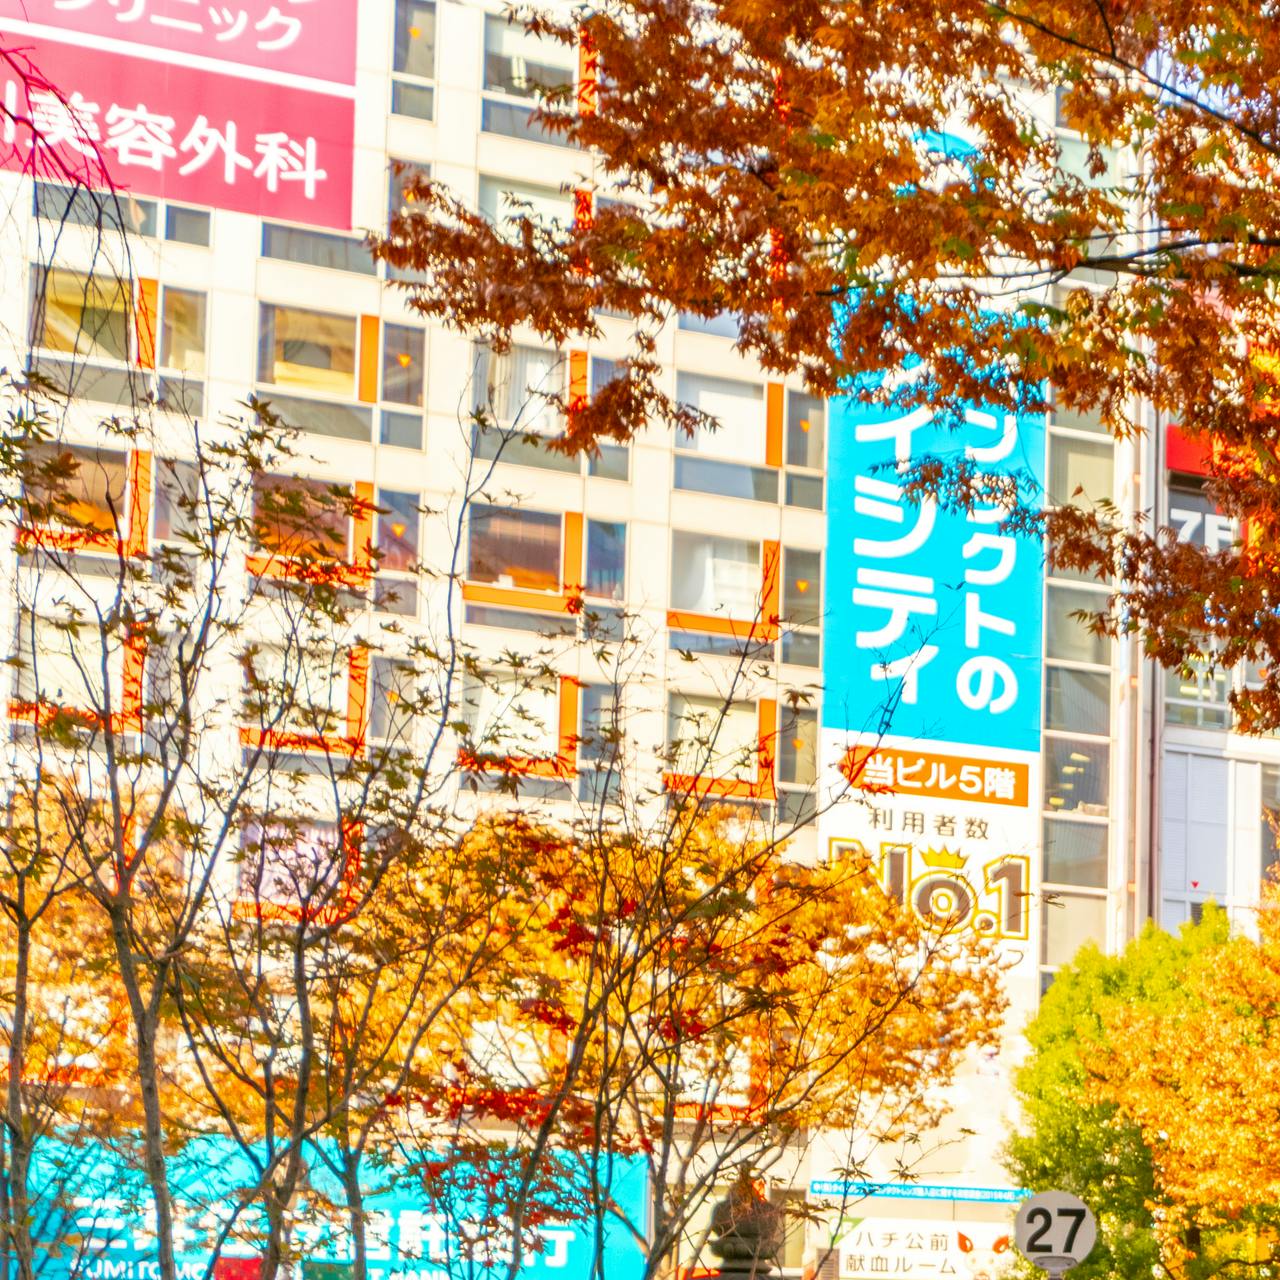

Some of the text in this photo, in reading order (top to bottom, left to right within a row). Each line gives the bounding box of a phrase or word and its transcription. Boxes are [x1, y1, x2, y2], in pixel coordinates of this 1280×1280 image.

[862, 753, 1016, 800] 当ビル5階
[869, 807, 989, 840] 利用者数
[855, 1230, 949, 1252] ハチ公前
[1026, 1207, 1087, 1254] 27
[845, 1254, 957, 1275] 献血ルーム
